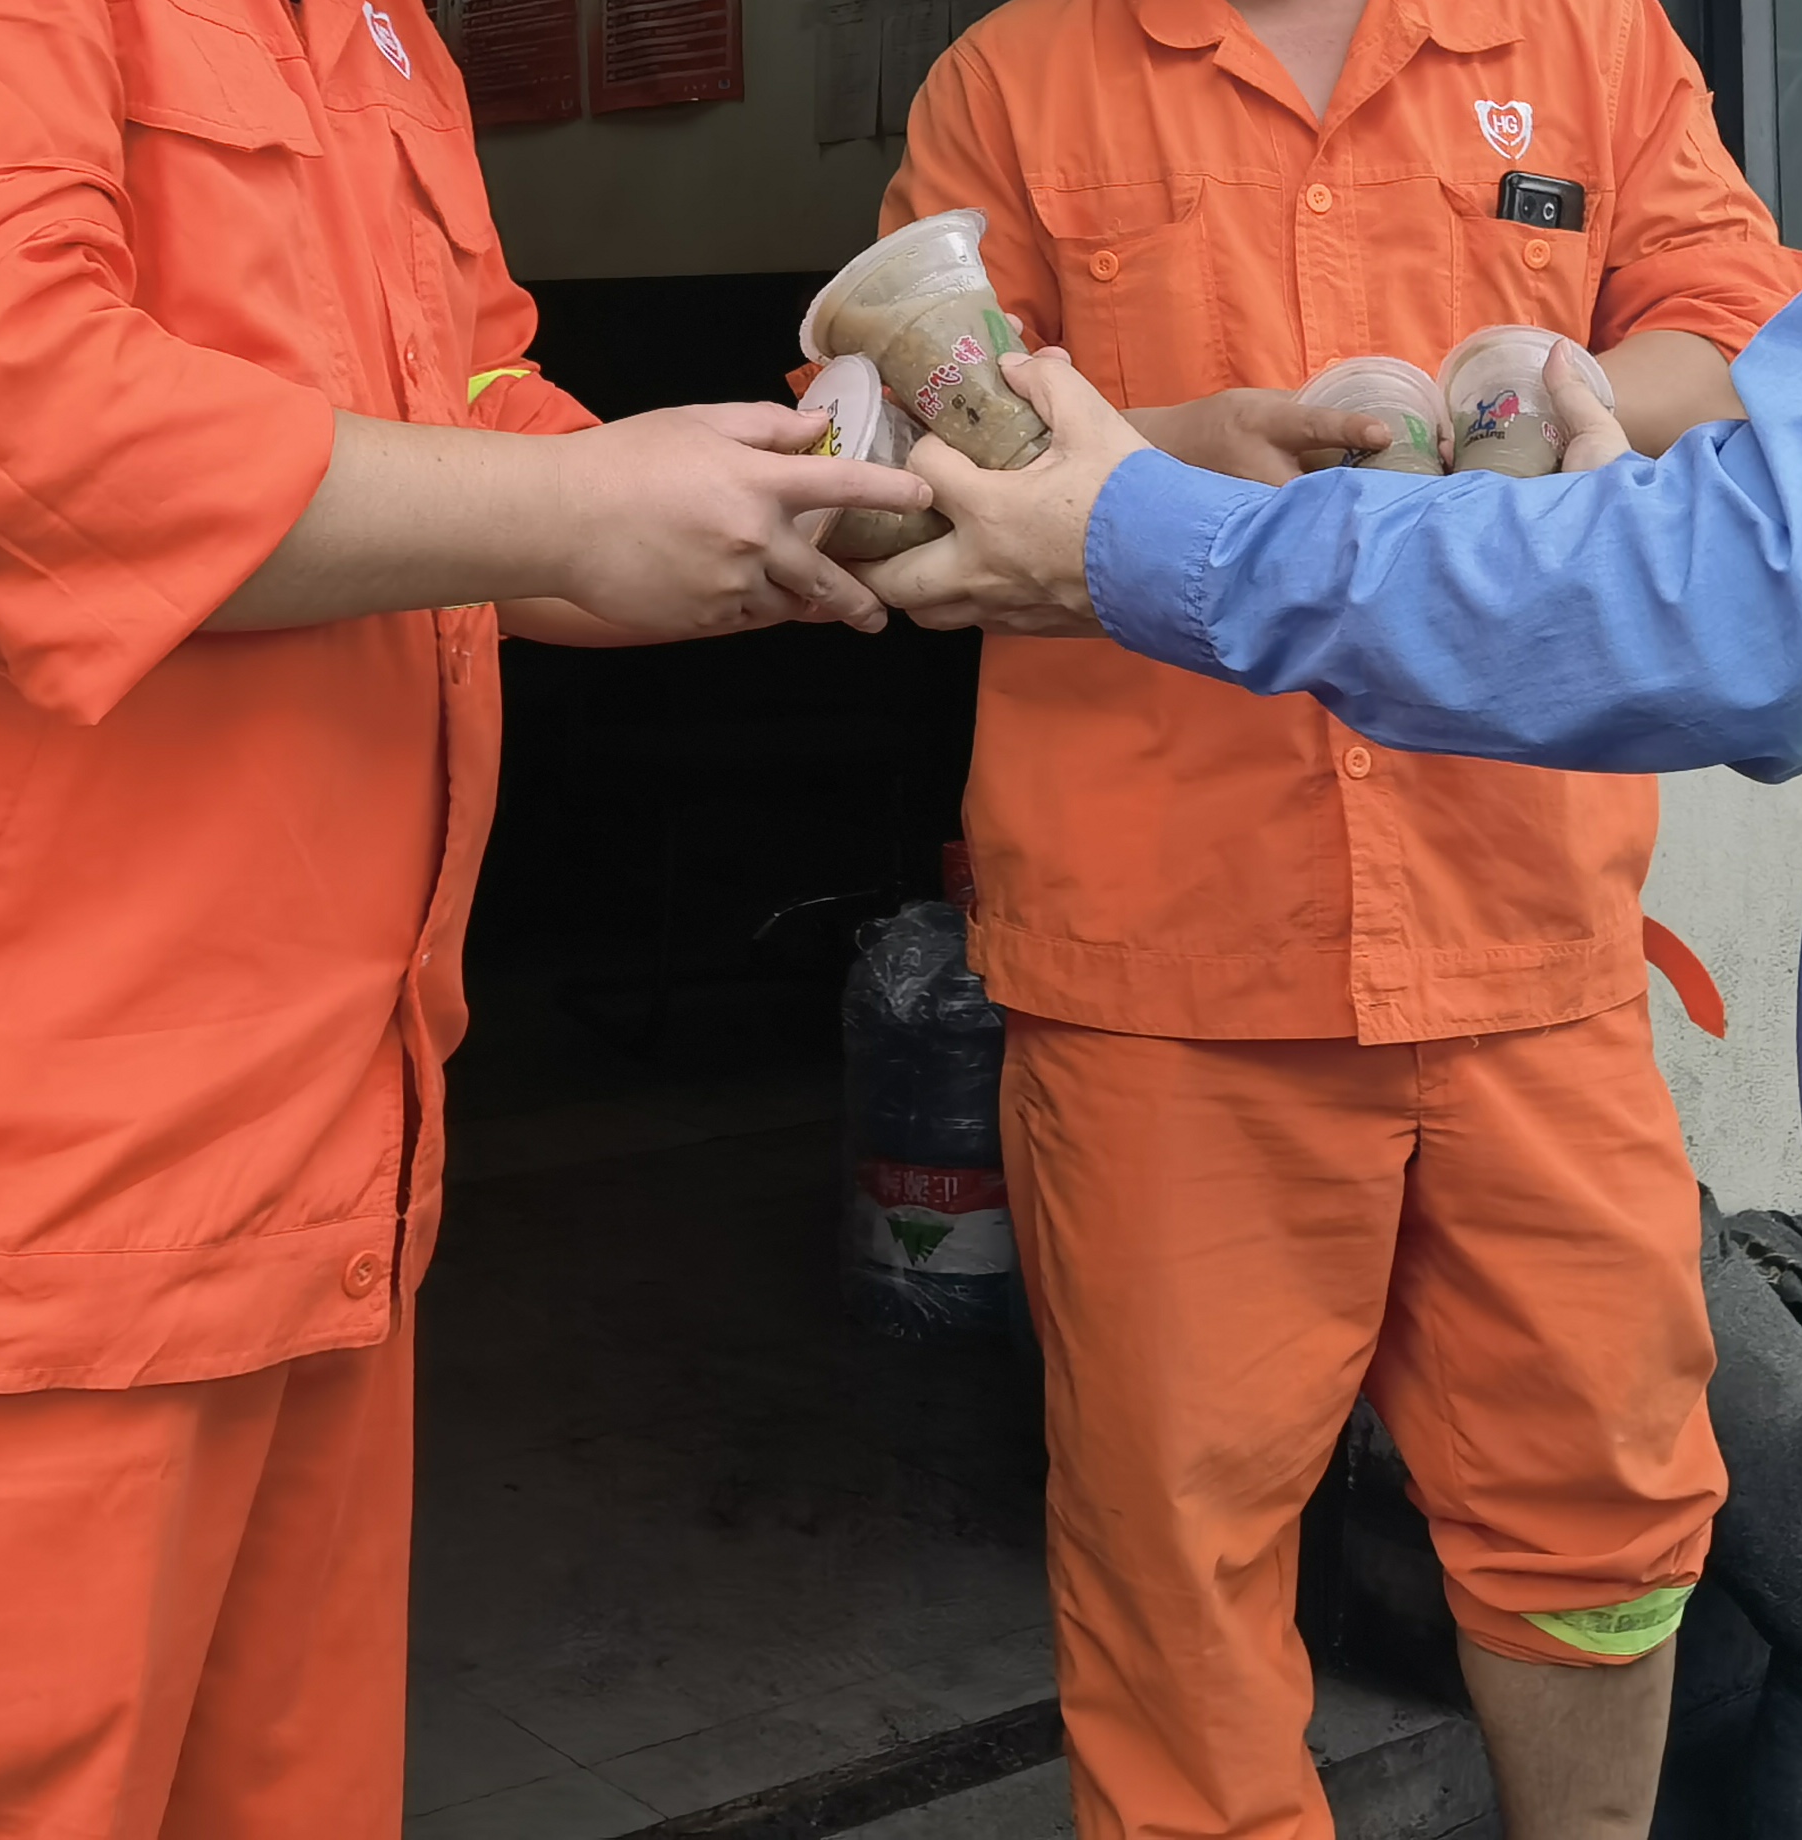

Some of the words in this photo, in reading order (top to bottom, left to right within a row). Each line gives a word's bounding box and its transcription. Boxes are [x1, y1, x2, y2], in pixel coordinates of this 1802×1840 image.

[1493, 114, 1519, 135] HG
[914, 334, 988, 420] 好心情
